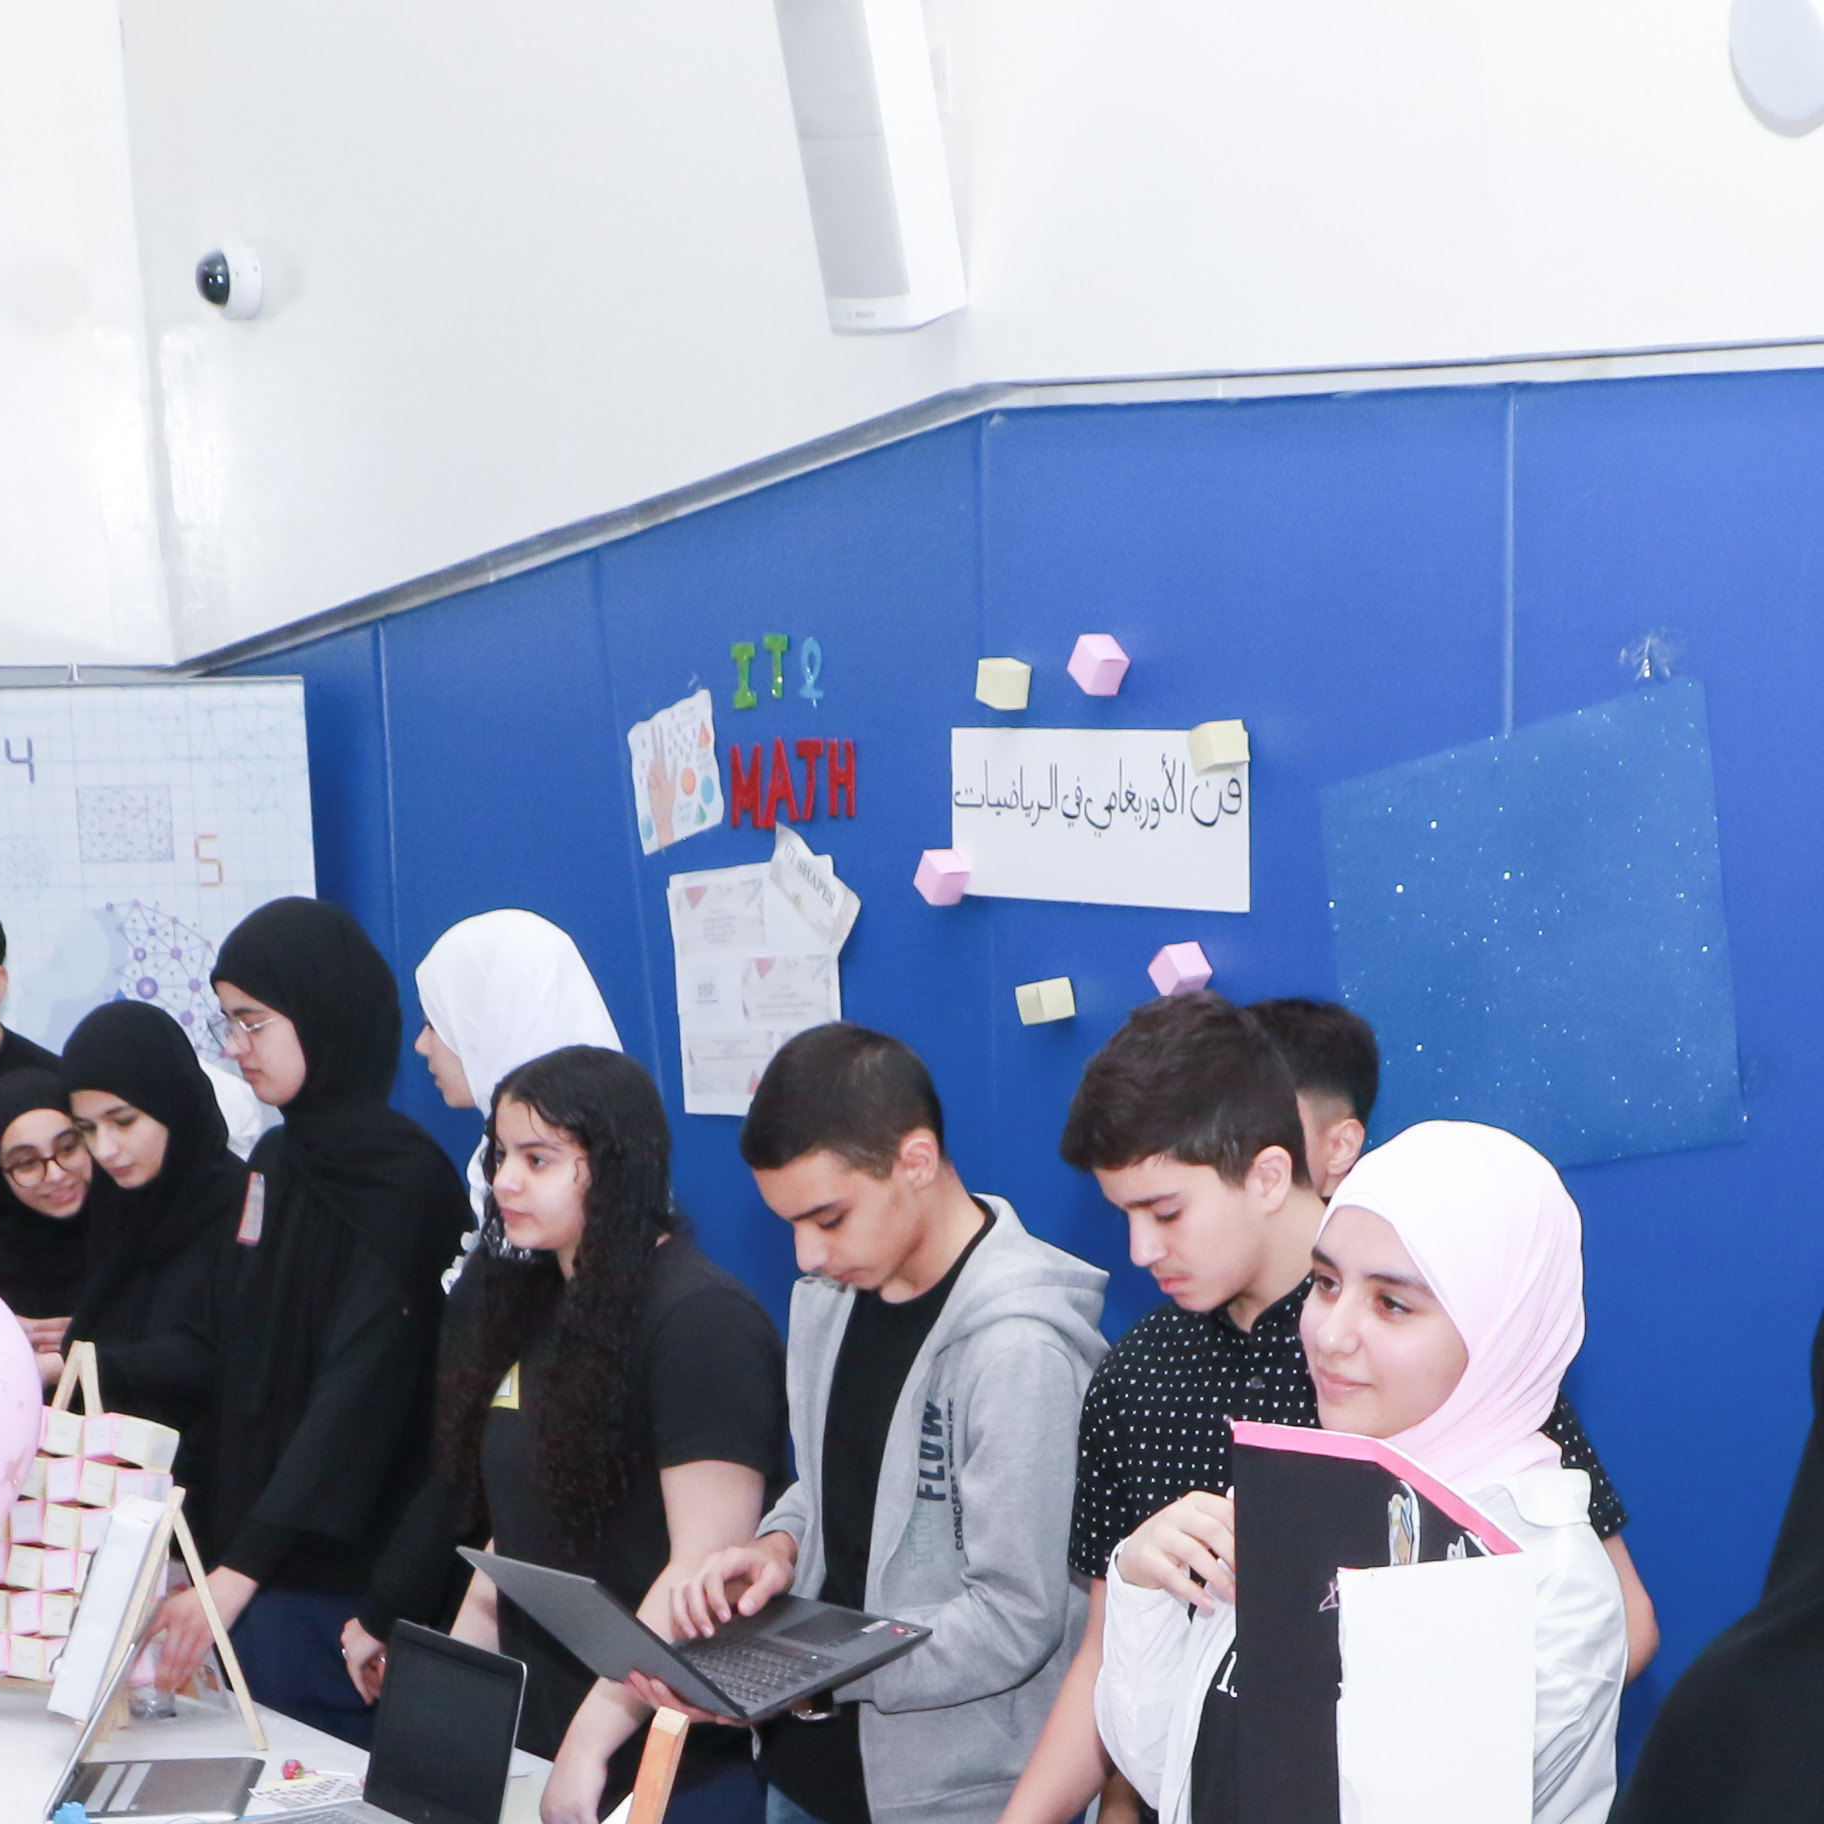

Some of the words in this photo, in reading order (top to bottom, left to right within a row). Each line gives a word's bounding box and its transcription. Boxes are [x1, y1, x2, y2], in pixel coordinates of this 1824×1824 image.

[4, 737, 35, 784] 4
[730, 737, 856, 830] MATH
[953, 759, 1059, 827] الرياضيات
[1060, 776, 1083, 828] في
[1084, 753, 1186, 837] الأوريغامي
[1190, 769, 1243, 827] فن
[194, 834, 223, 887] 5
[917, 1399, 946, 1501] FLOW
